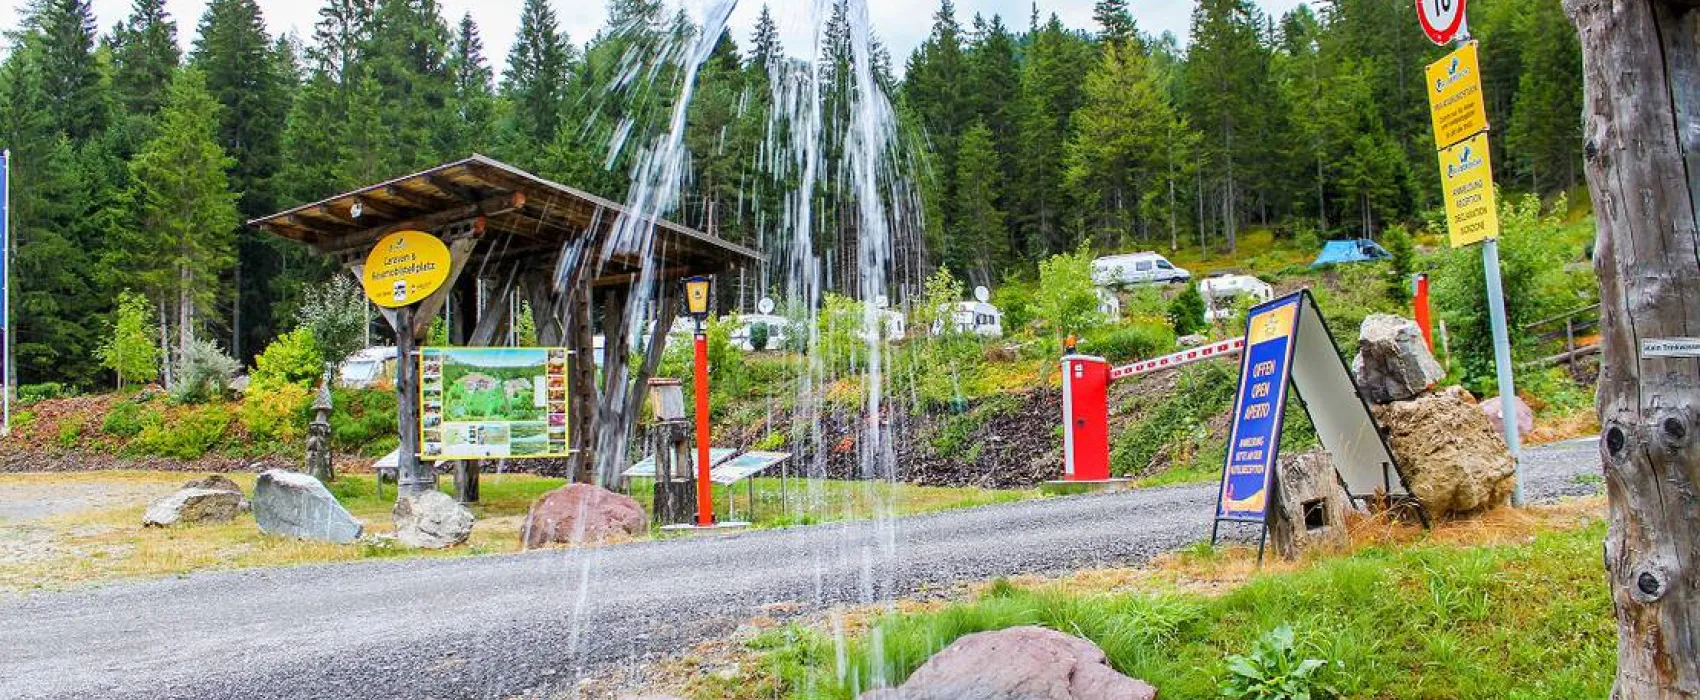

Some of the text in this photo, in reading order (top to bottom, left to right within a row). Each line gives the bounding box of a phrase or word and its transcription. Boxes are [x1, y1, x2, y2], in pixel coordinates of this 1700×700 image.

[1253, 361, 1276, 378] OFFEN
[1252, 382, 1270, 399] OPEN
[1244, 403, 1270, 420] APERTO
